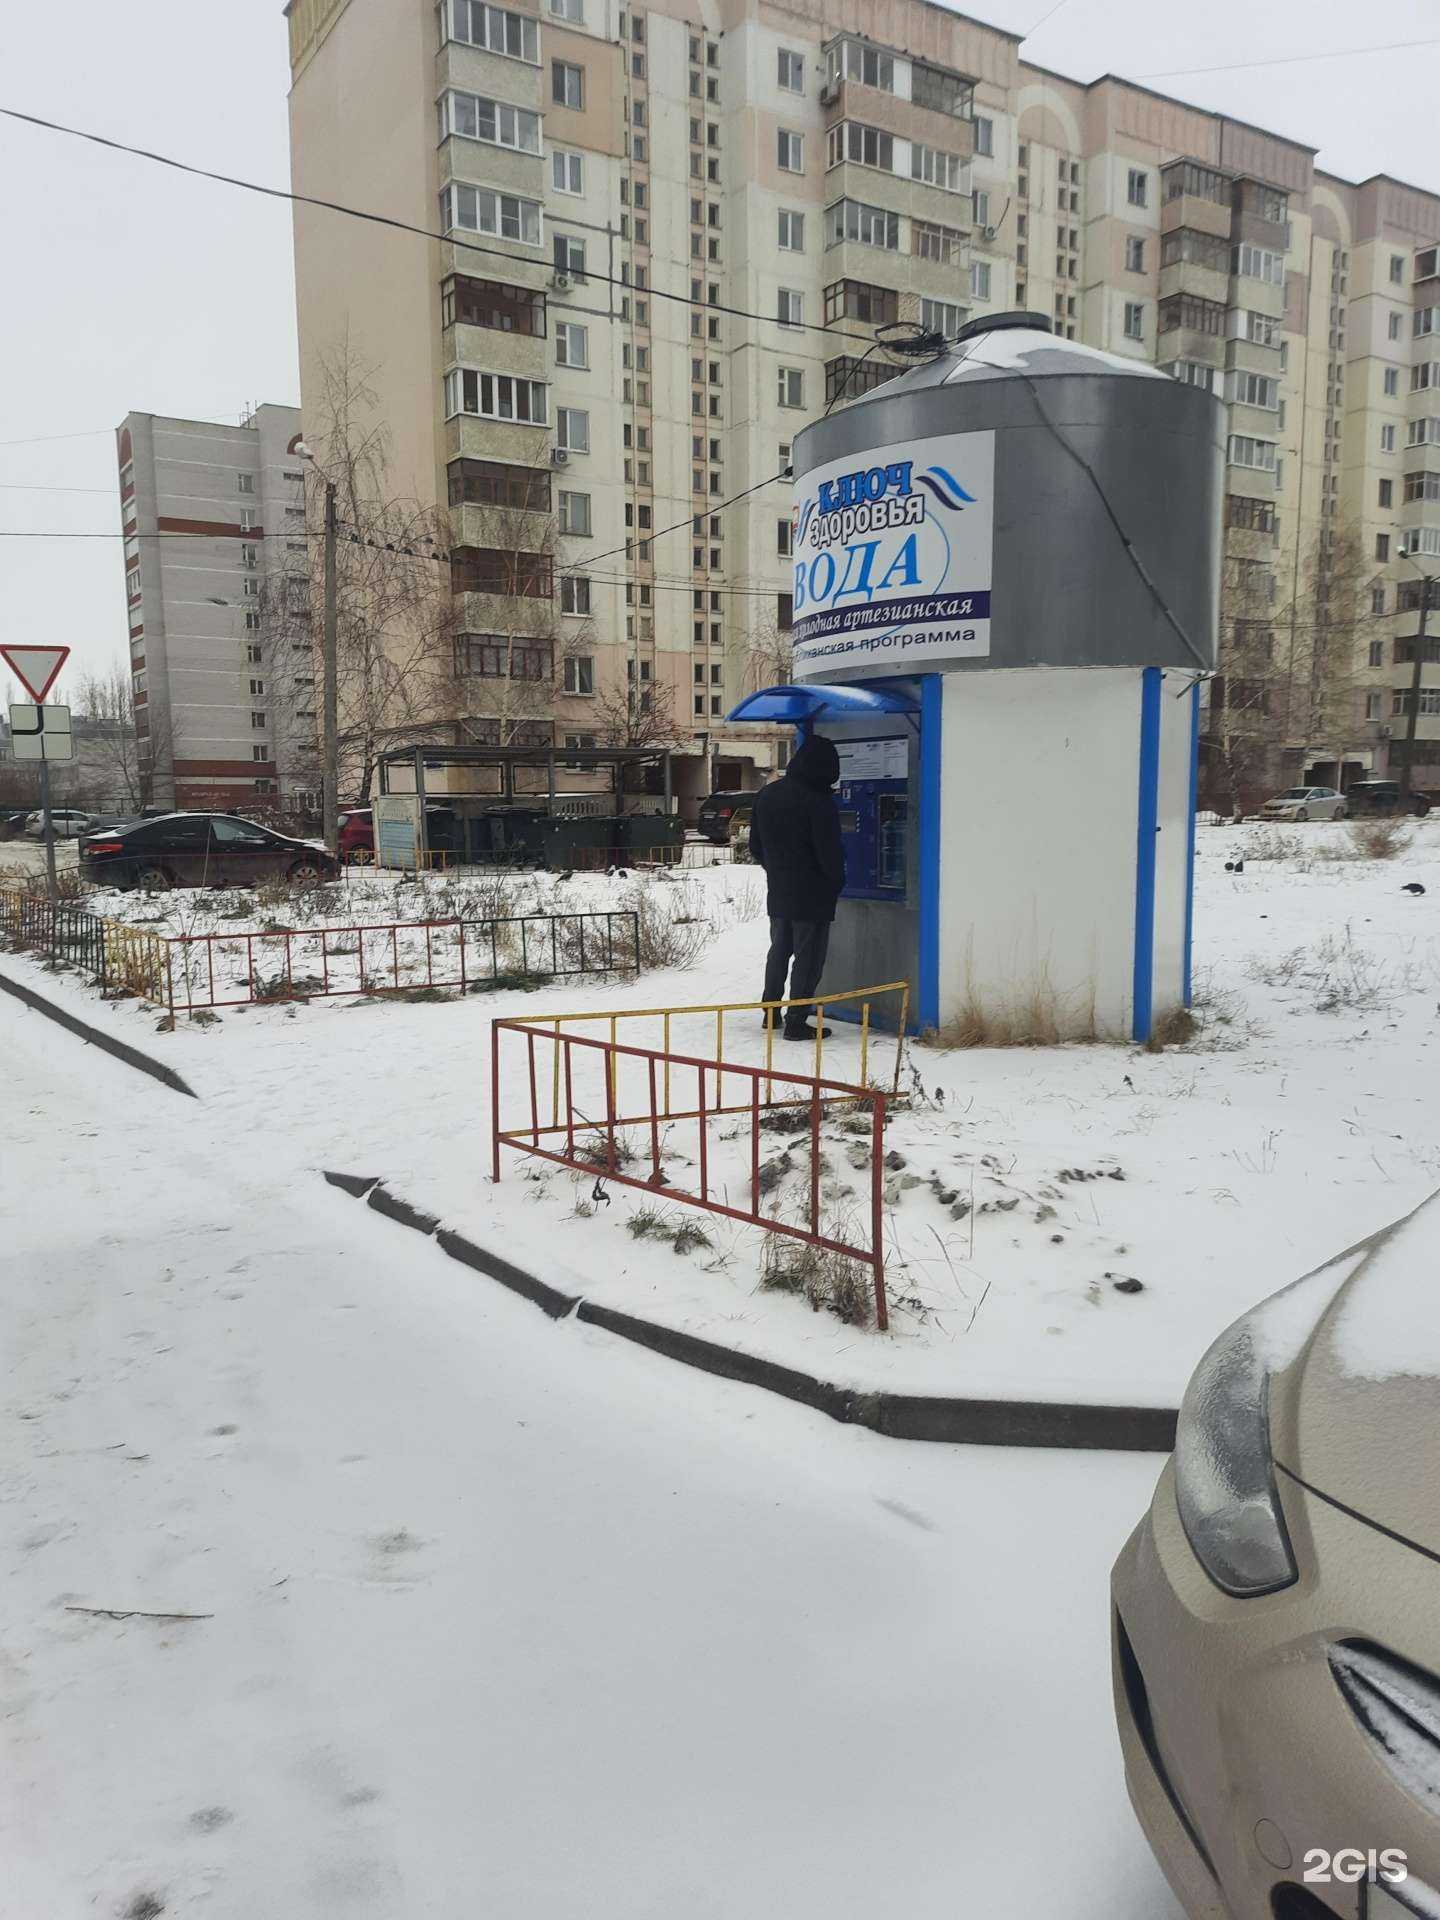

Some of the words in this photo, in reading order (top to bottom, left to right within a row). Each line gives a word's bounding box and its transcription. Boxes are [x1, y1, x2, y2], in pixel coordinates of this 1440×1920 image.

[793, 533, 922, 612] ВОДА
[843, 599, 973, 631] артезианская
[859, 629, 977, 652] программа
